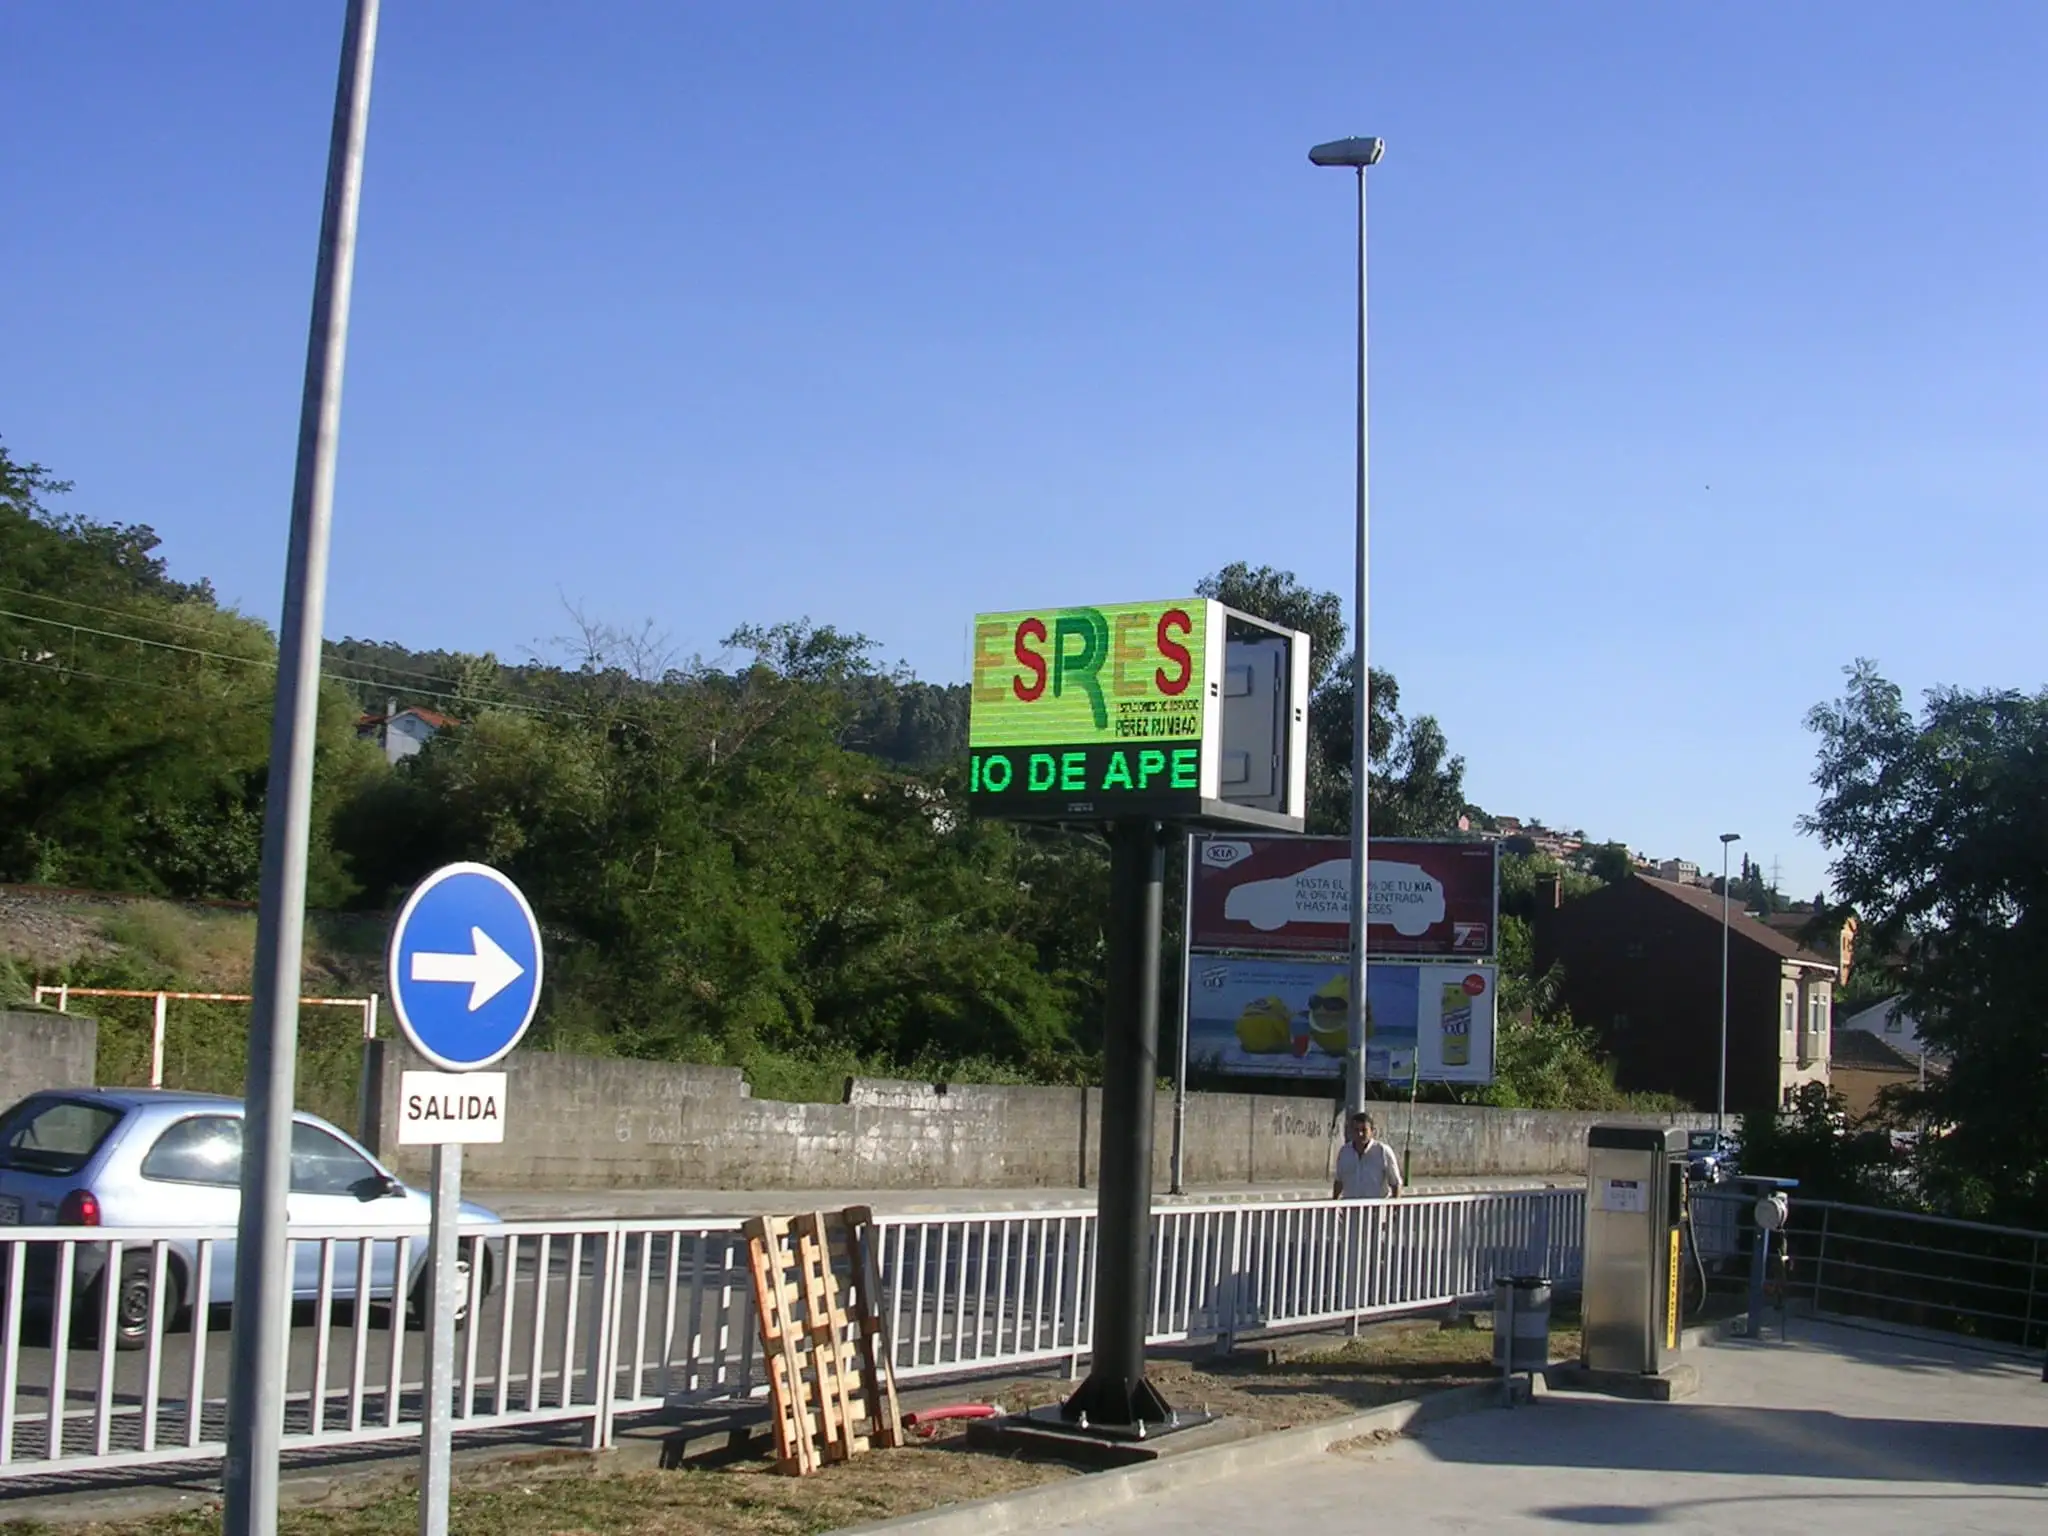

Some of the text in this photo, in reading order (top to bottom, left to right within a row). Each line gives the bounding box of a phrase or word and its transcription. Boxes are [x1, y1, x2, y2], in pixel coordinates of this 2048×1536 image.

[1028, 752, 1086, 791] DE
[1102, 749, 1198, 789] APE
[1212, 848, 1233, 858] KIA
[1295, 878, 1330, 890] HASTA
[1333, 879, 1344, 890] EL
[1380, 881, 1395, 892] DE
[1398, 881, 1411, 892] TU
[1414, 882, 1433, 893] KIA
[1375, 893, 1425, 904] ENTRADA
[1303, 901, 1339, 912] HASTA
[1368, 903, 1393, 915] ESES
[407, 1095, 498, 1120] SALIDA
